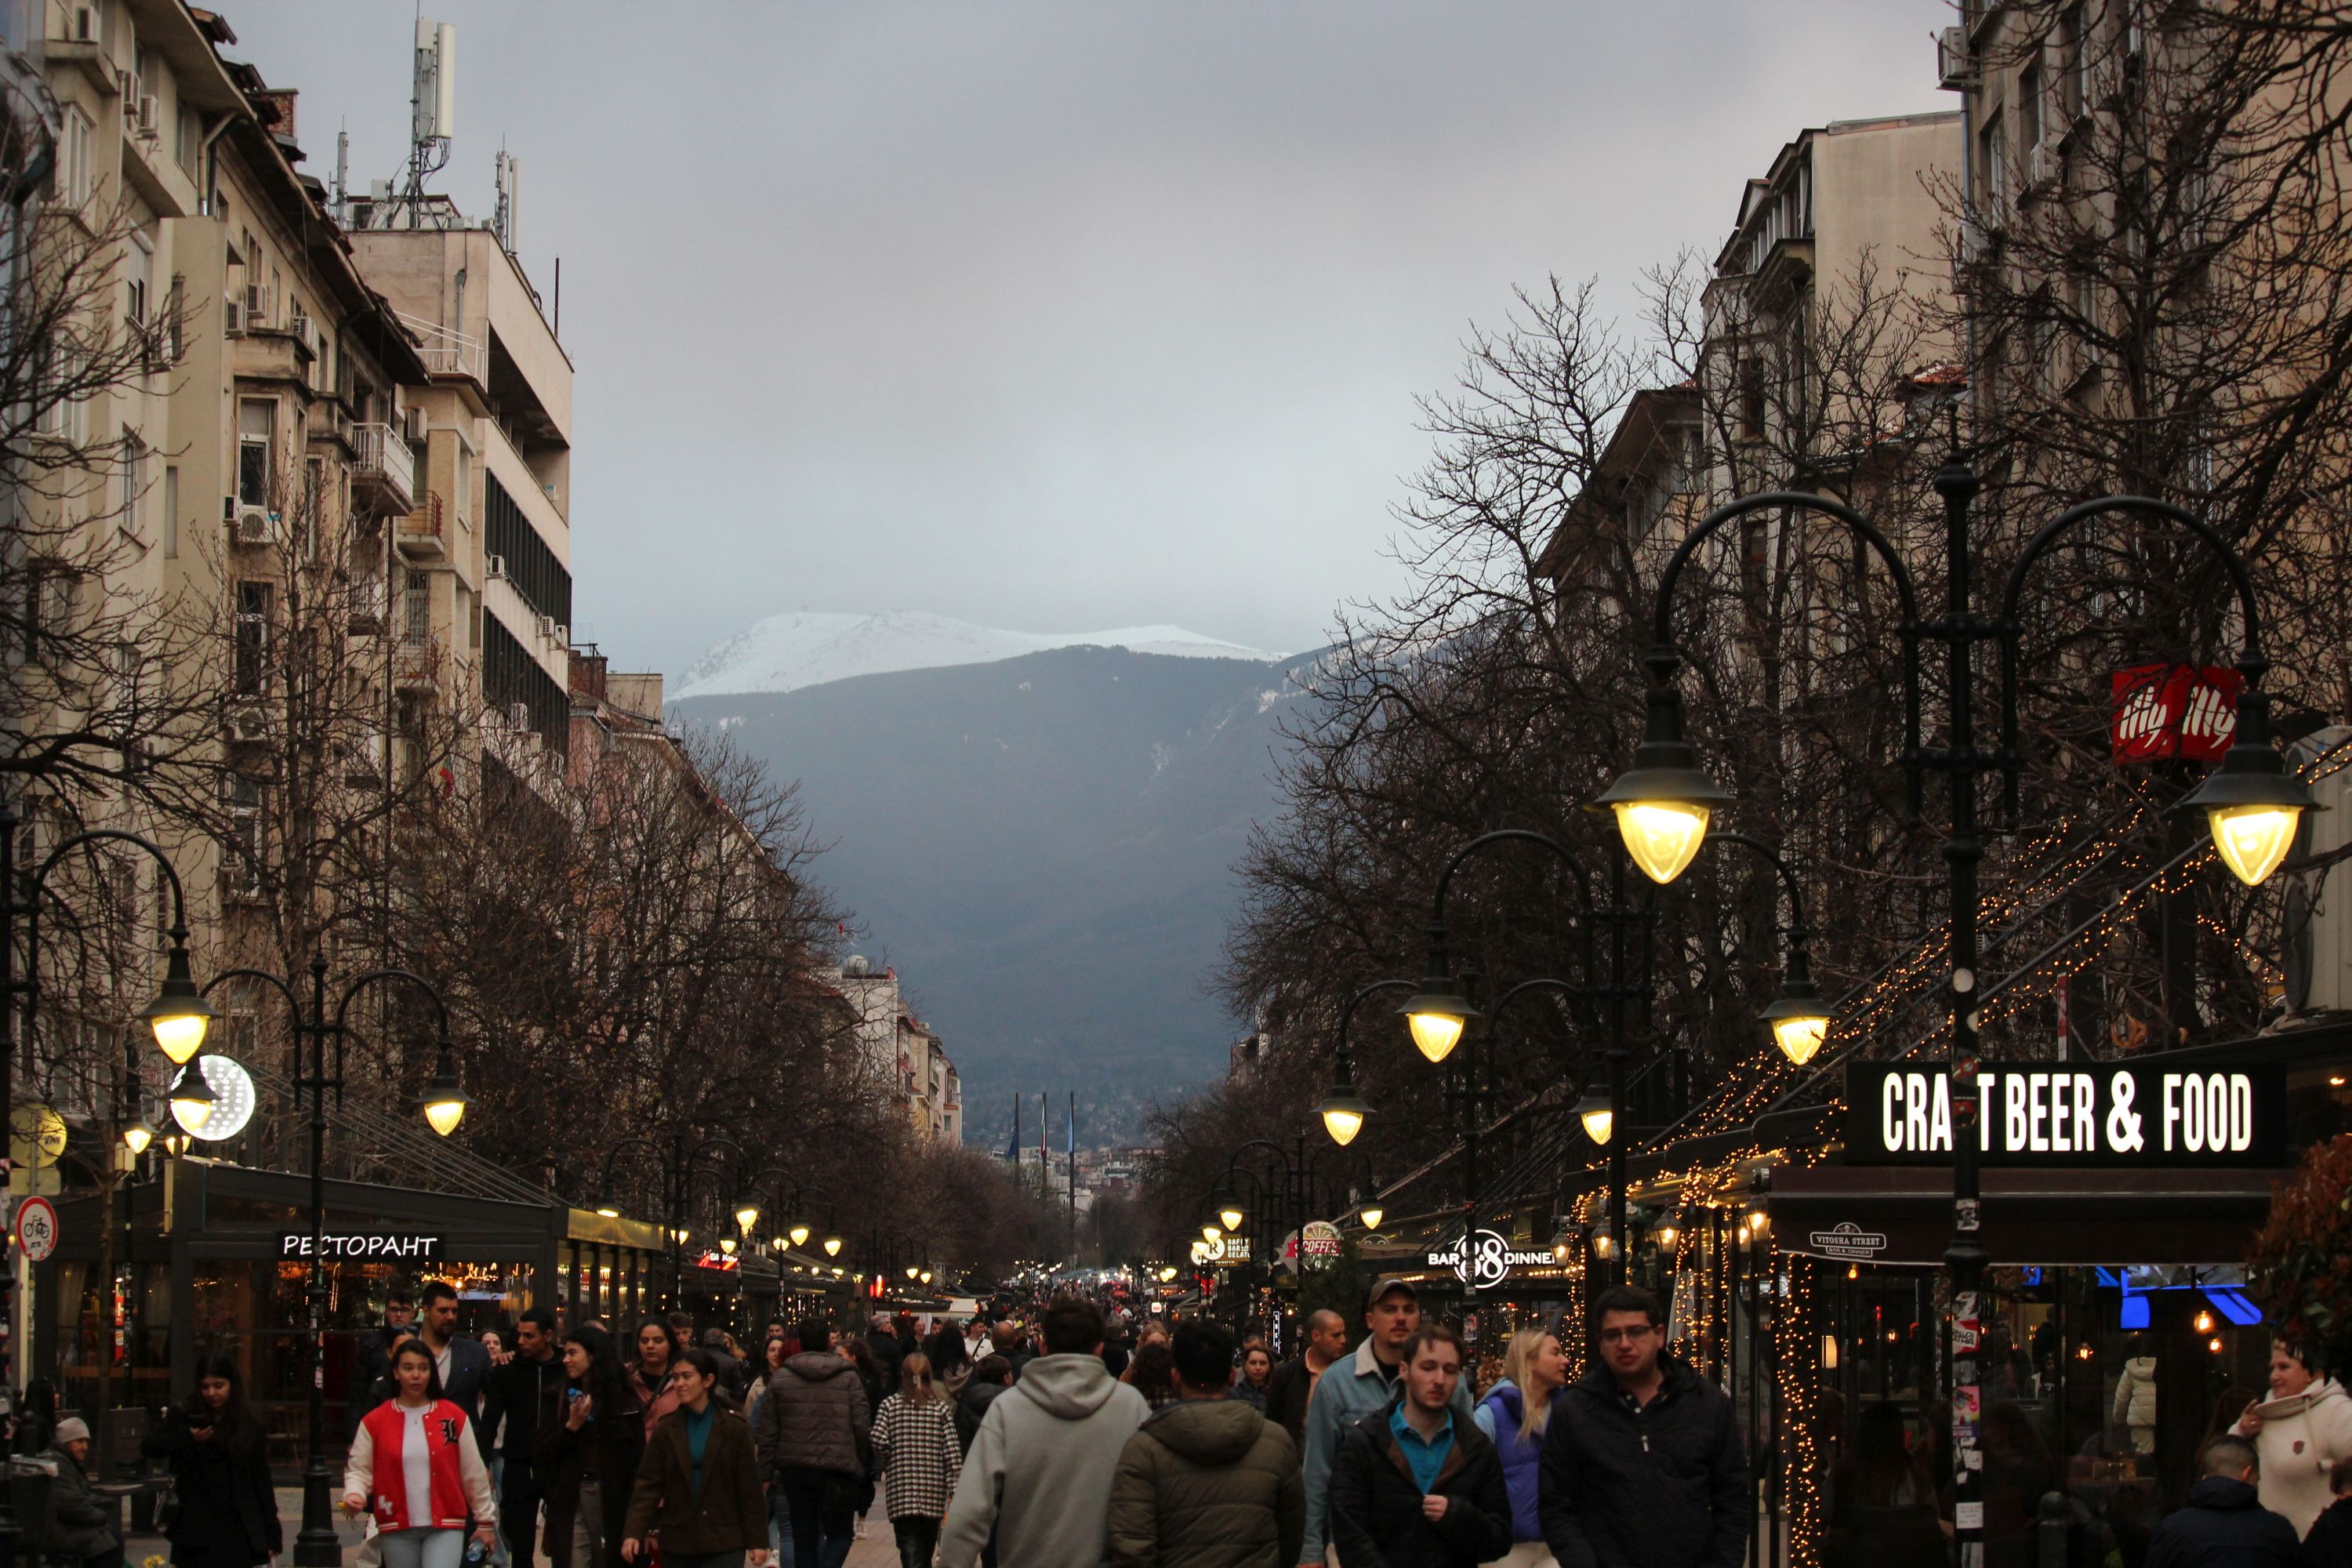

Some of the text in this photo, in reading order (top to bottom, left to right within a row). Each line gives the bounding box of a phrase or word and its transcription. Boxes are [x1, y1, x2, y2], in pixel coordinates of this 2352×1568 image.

[2119, 686, 2167, 749] illy
[2182, 686, 2237, 749] illy
[1882, 1070, 2252, 1153] CRAT BEER & FOOD
[283, 1236, 438, 1256] РЕСТОРАНТ
[1428, 1253, 1460, 1265] BAR
[1852, 1237, 1880, 1246] STREET
